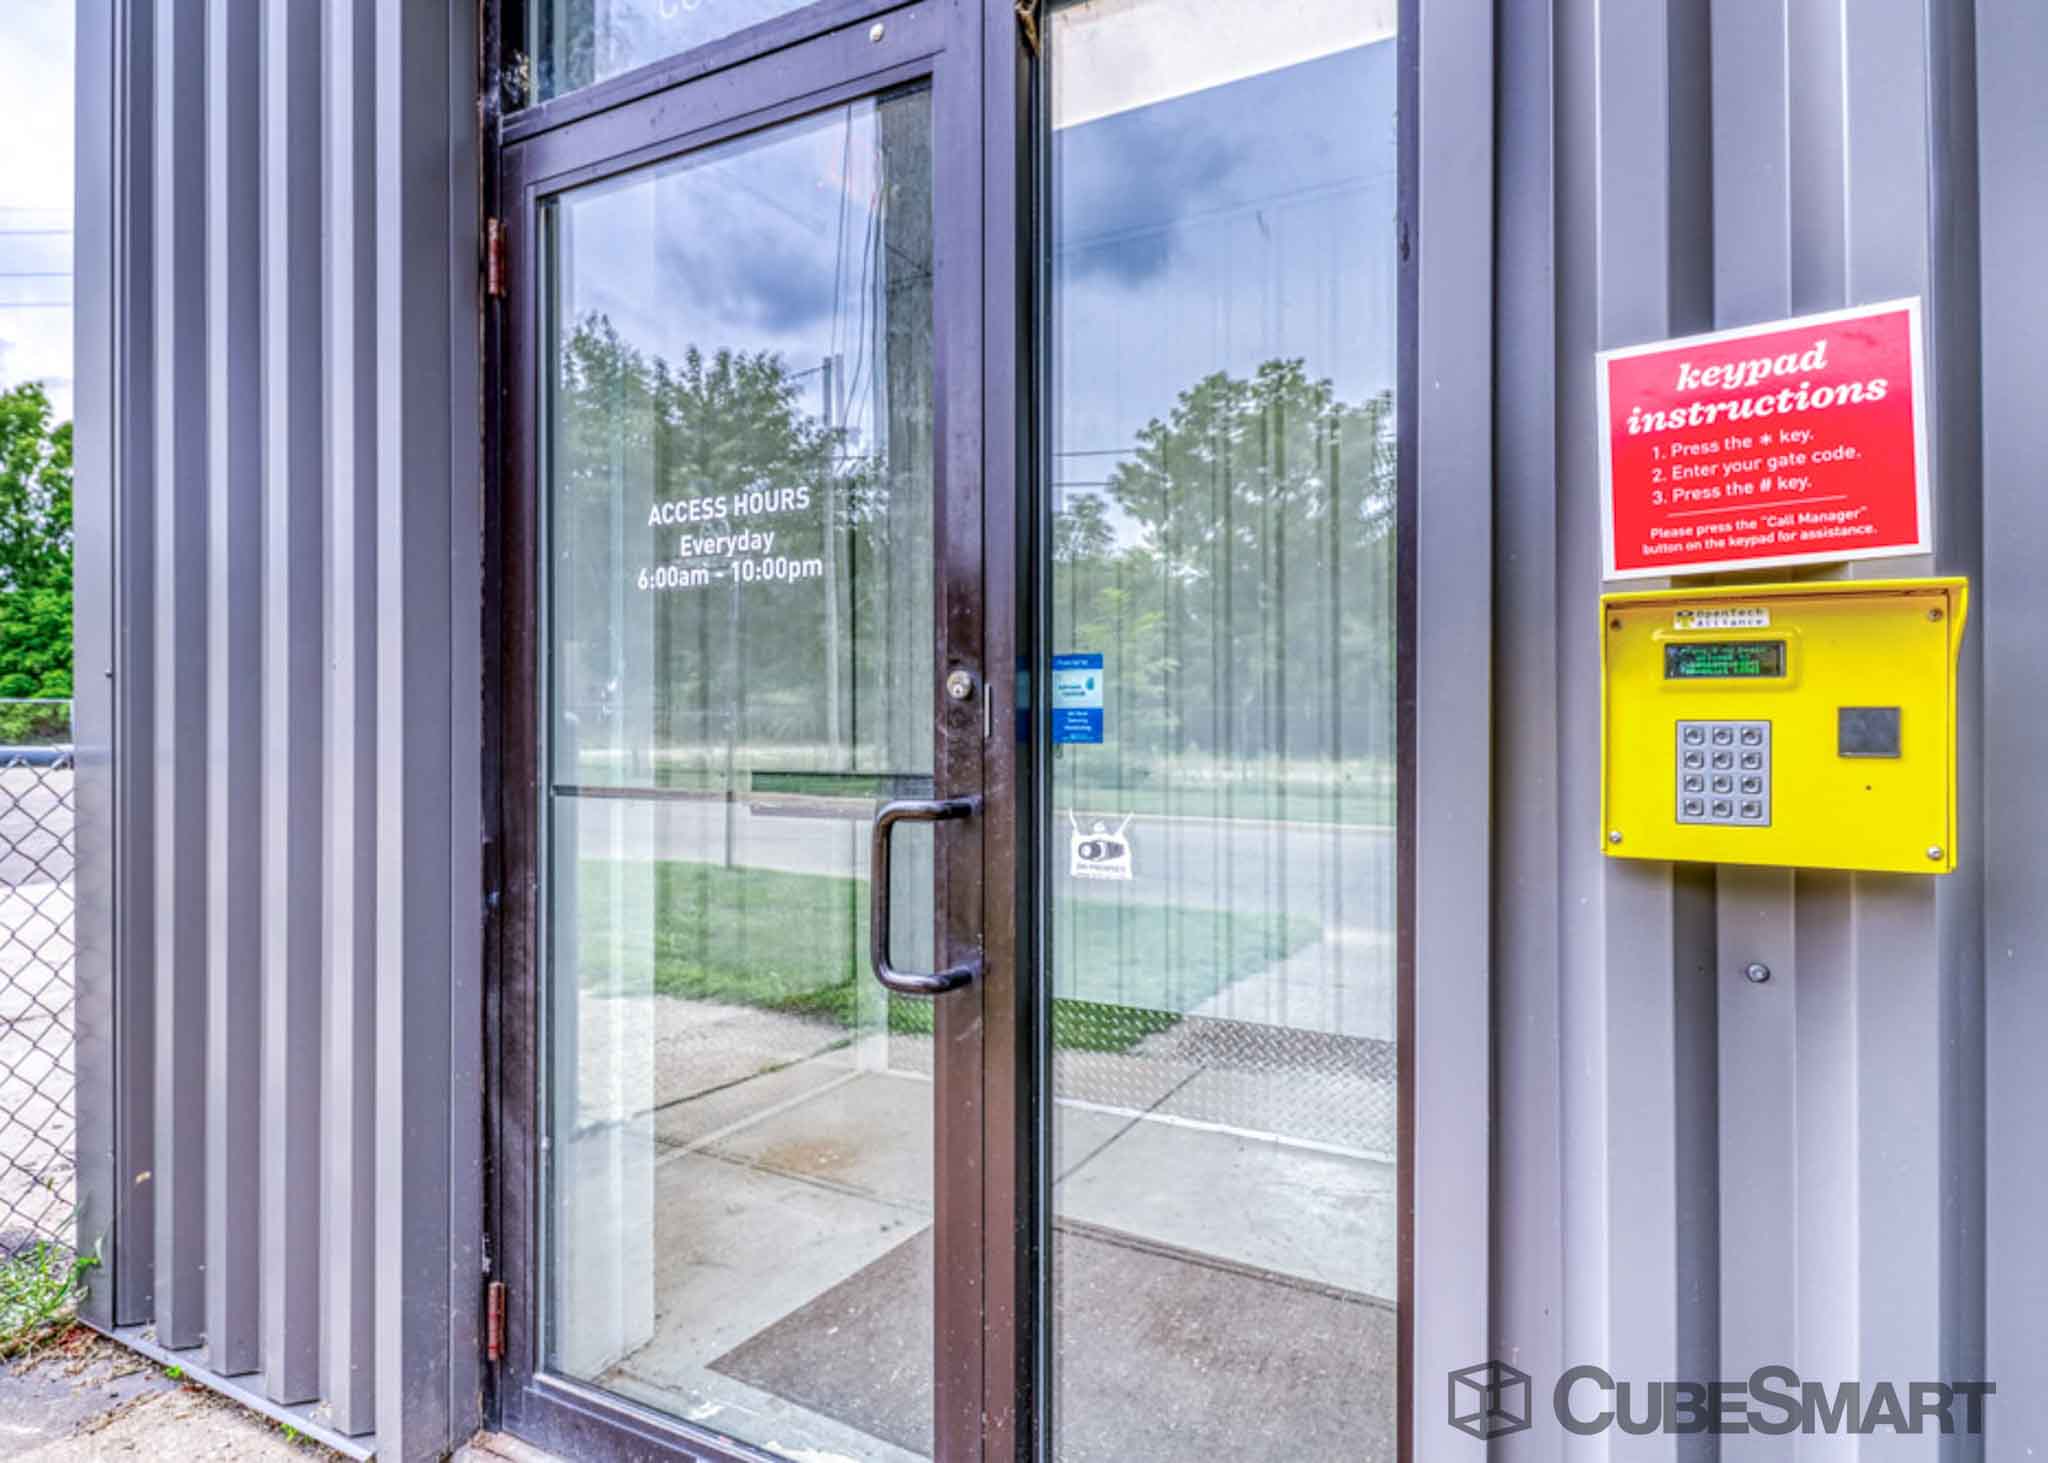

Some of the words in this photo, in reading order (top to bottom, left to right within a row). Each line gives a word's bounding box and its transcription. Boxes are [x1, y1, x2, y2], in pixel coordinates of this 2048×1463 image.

[1676, 340, 1829, 392] keypad
[1626, 378, 1889, 436] instructions
[1652, 446, 1666, 461] 1.
[1671, 440, 1720, 457] Press
[1724, 435, 1753, 450] the
[1779, 429, 1814, 445] key.
[1652, 468, 1667, 483] 2.
[1672, 464, 1718, 480] Enter
[1722, 458, 1761, 476] your
[1766, 452, 1806, 472] gate
[1811, 445, 1862, 463] code.
[647, 496, 728, 526] ACCESS
[733, 486, 811, 517] HOURS
[1652, 490, 1667, 505] 3.
[1672, 486, 1721, 503] Press
[1725, 481, 1754, 496] the
[1759, 478, 1772, 492] #
[1777, 475, 1813, 491] key.
[680, 529, 775, 557] Everyday
[1641, 542, 1684, 556] button
[1685, 540, 1703, 551] on
[1704, 536, 1725, 550] the
[1728, 530, 1775, 548] keypad
[1777, 528, 1798, 542] for
[1650, 526, 1694, 540] Please
[1696, 521, 1733, 536] press
[1735, 517, 1758, 531] the
[637, 565, 709, 590] 6:00am
[730, 556, 823, 584] 10:00pm
